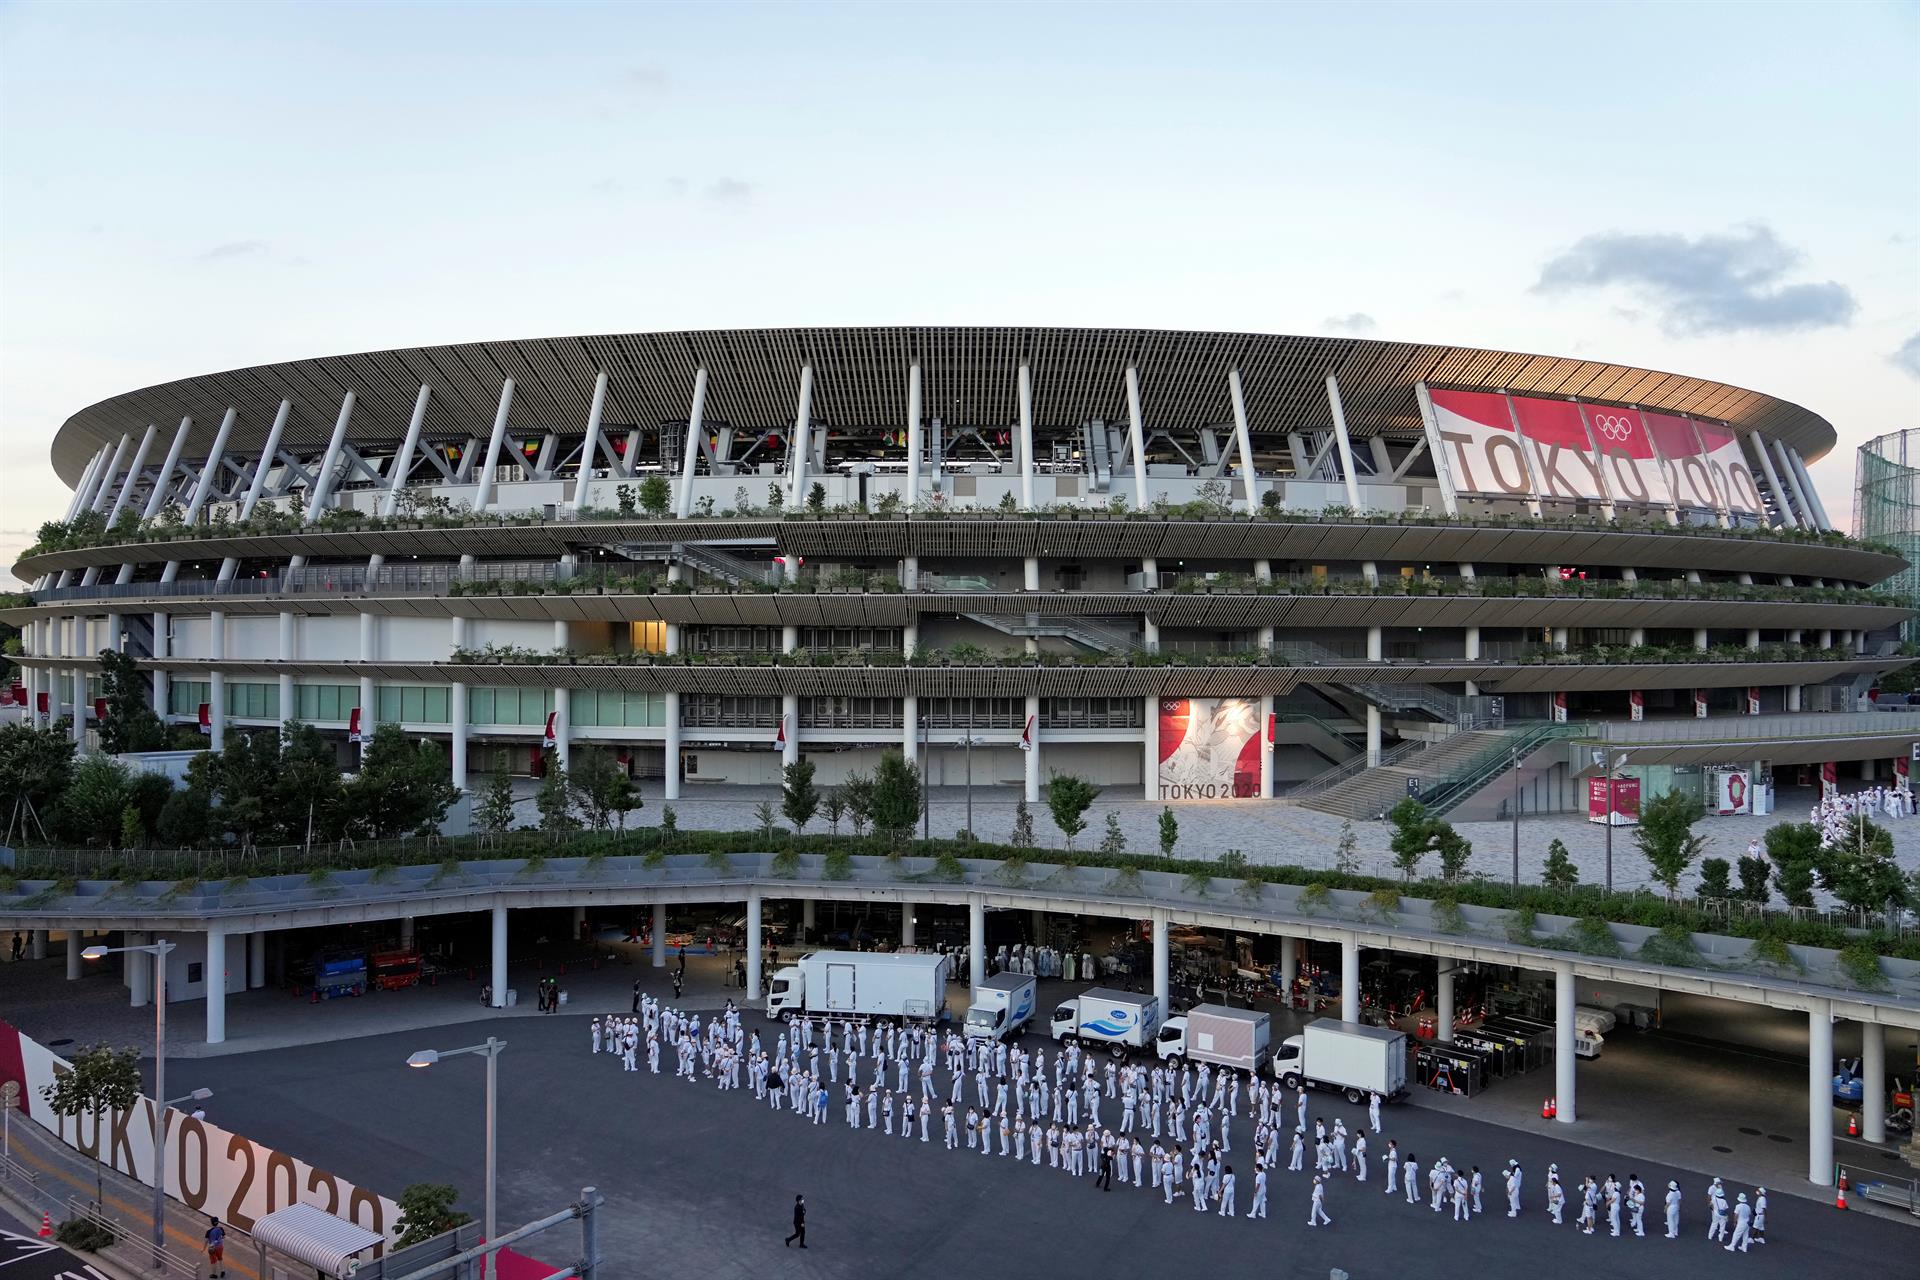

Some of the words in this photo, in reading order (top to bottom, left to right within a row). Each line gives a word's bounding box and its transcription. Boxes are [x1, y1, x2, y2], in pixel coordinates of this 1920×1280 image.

[1441, 431, 1649, 503] TOKYO
[1660, 453, 1762, 513] 2020
[1409, 778, 1418, 787] E1
[1160, 783, 1216, 800] TOKYO
[1220, 783, 1261, 799] 2020
